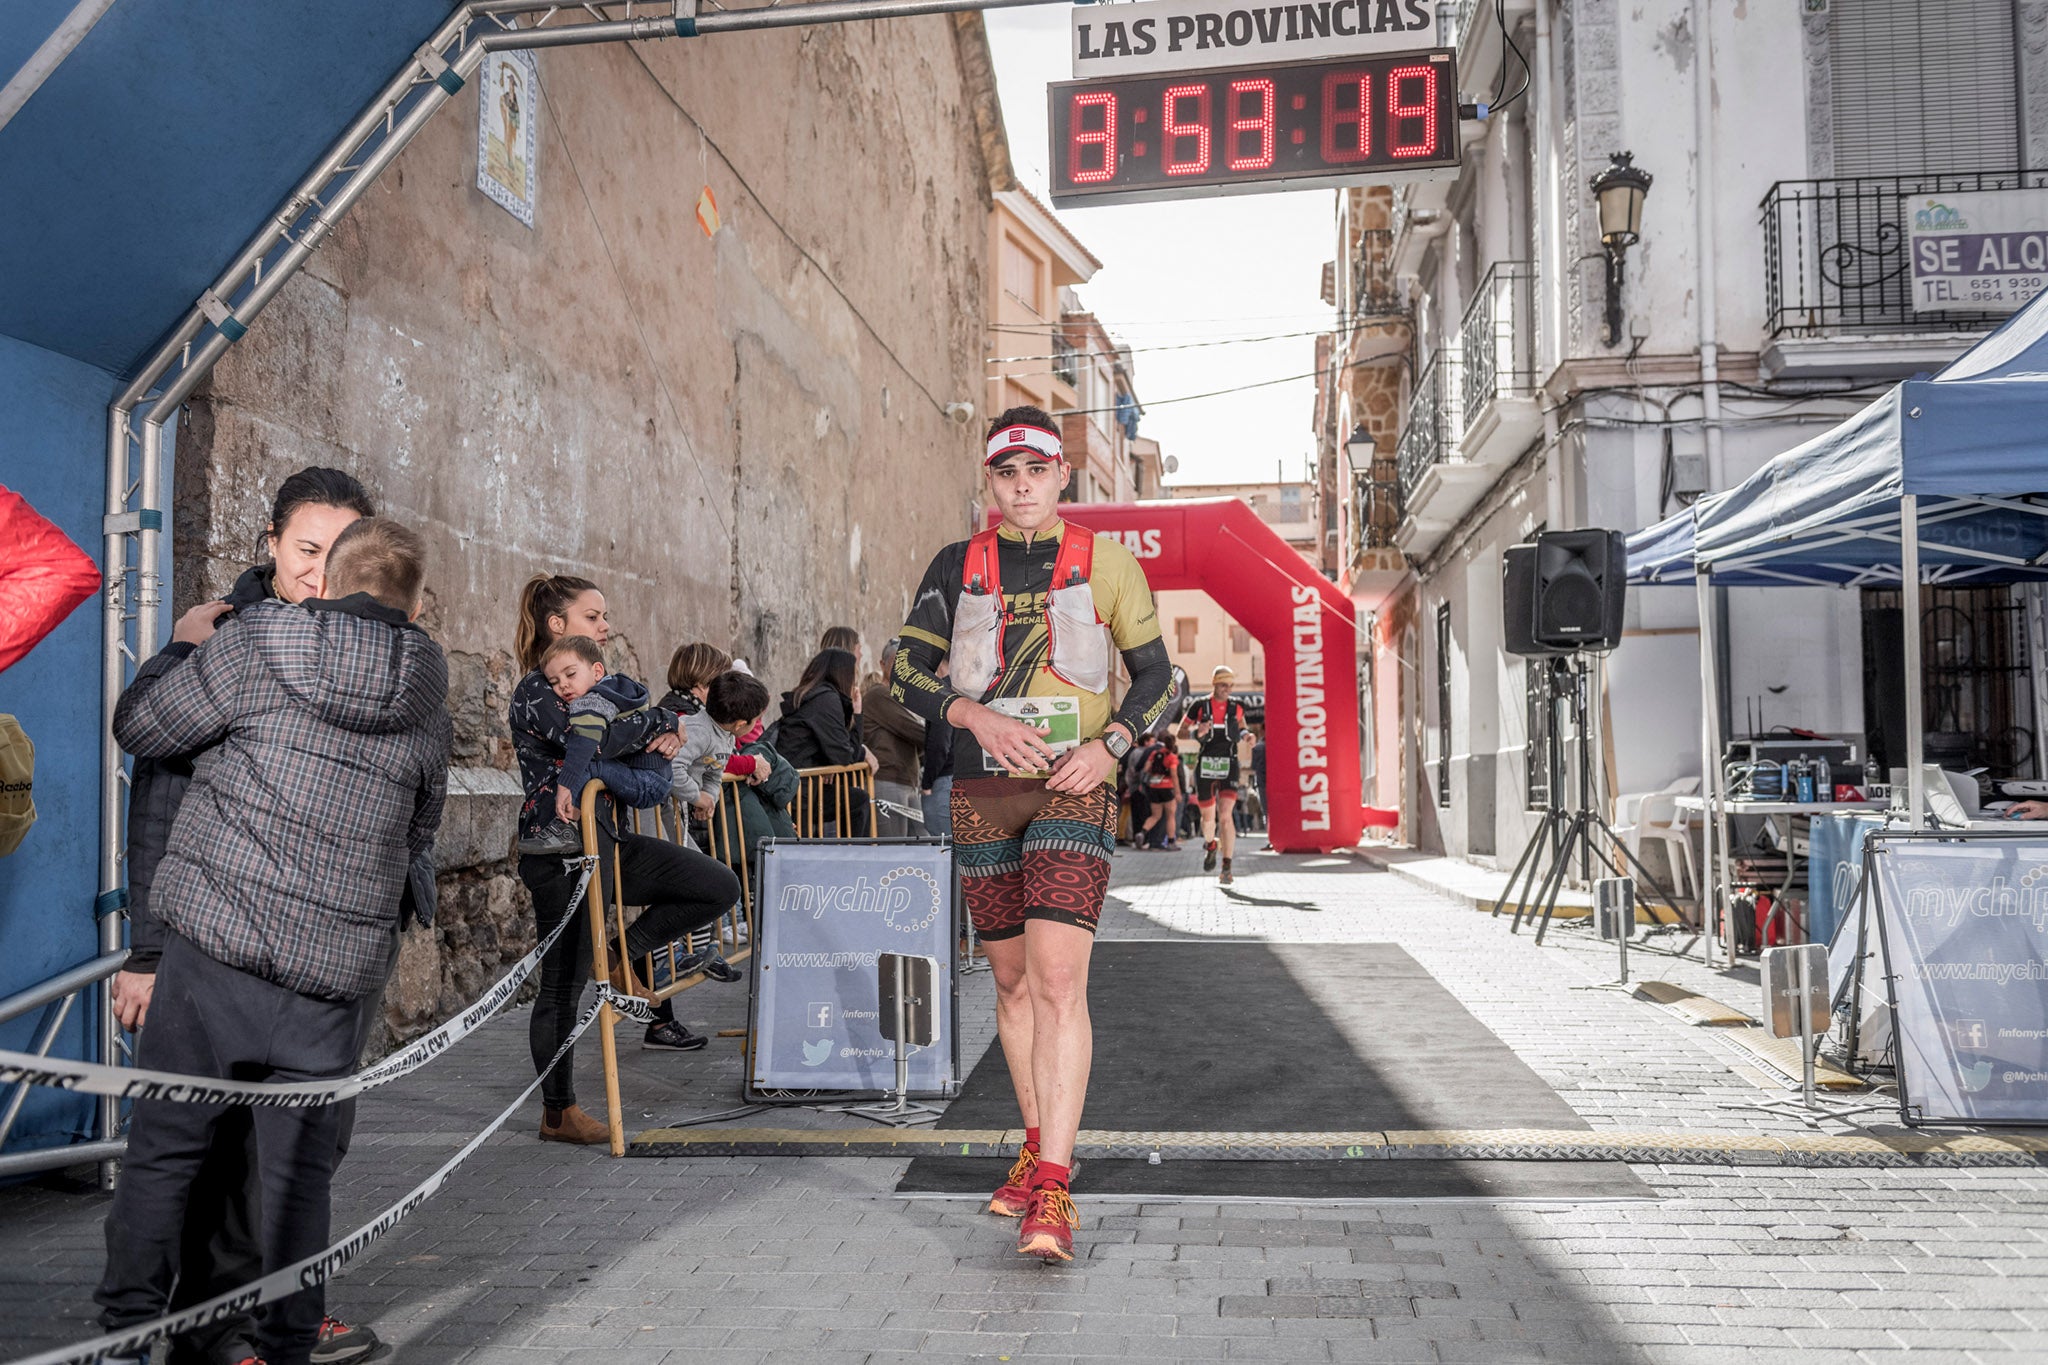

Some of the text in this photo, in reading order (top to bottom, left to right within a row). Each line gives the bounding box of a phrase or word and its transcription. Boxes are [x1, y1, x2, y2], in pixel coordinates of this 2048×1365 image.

[1078, 0, 1431, 59] LAS PROVINCIAS
[1920, 235, 2048, 272] SE ALQ
[1970, 277, 2041, 289] 651 930
[1971, 290, 2039, 301] 964 13
[1291, 585, 1331, 832] LAS PROVINCIAS
[779, 876, 911, 921] mychip
